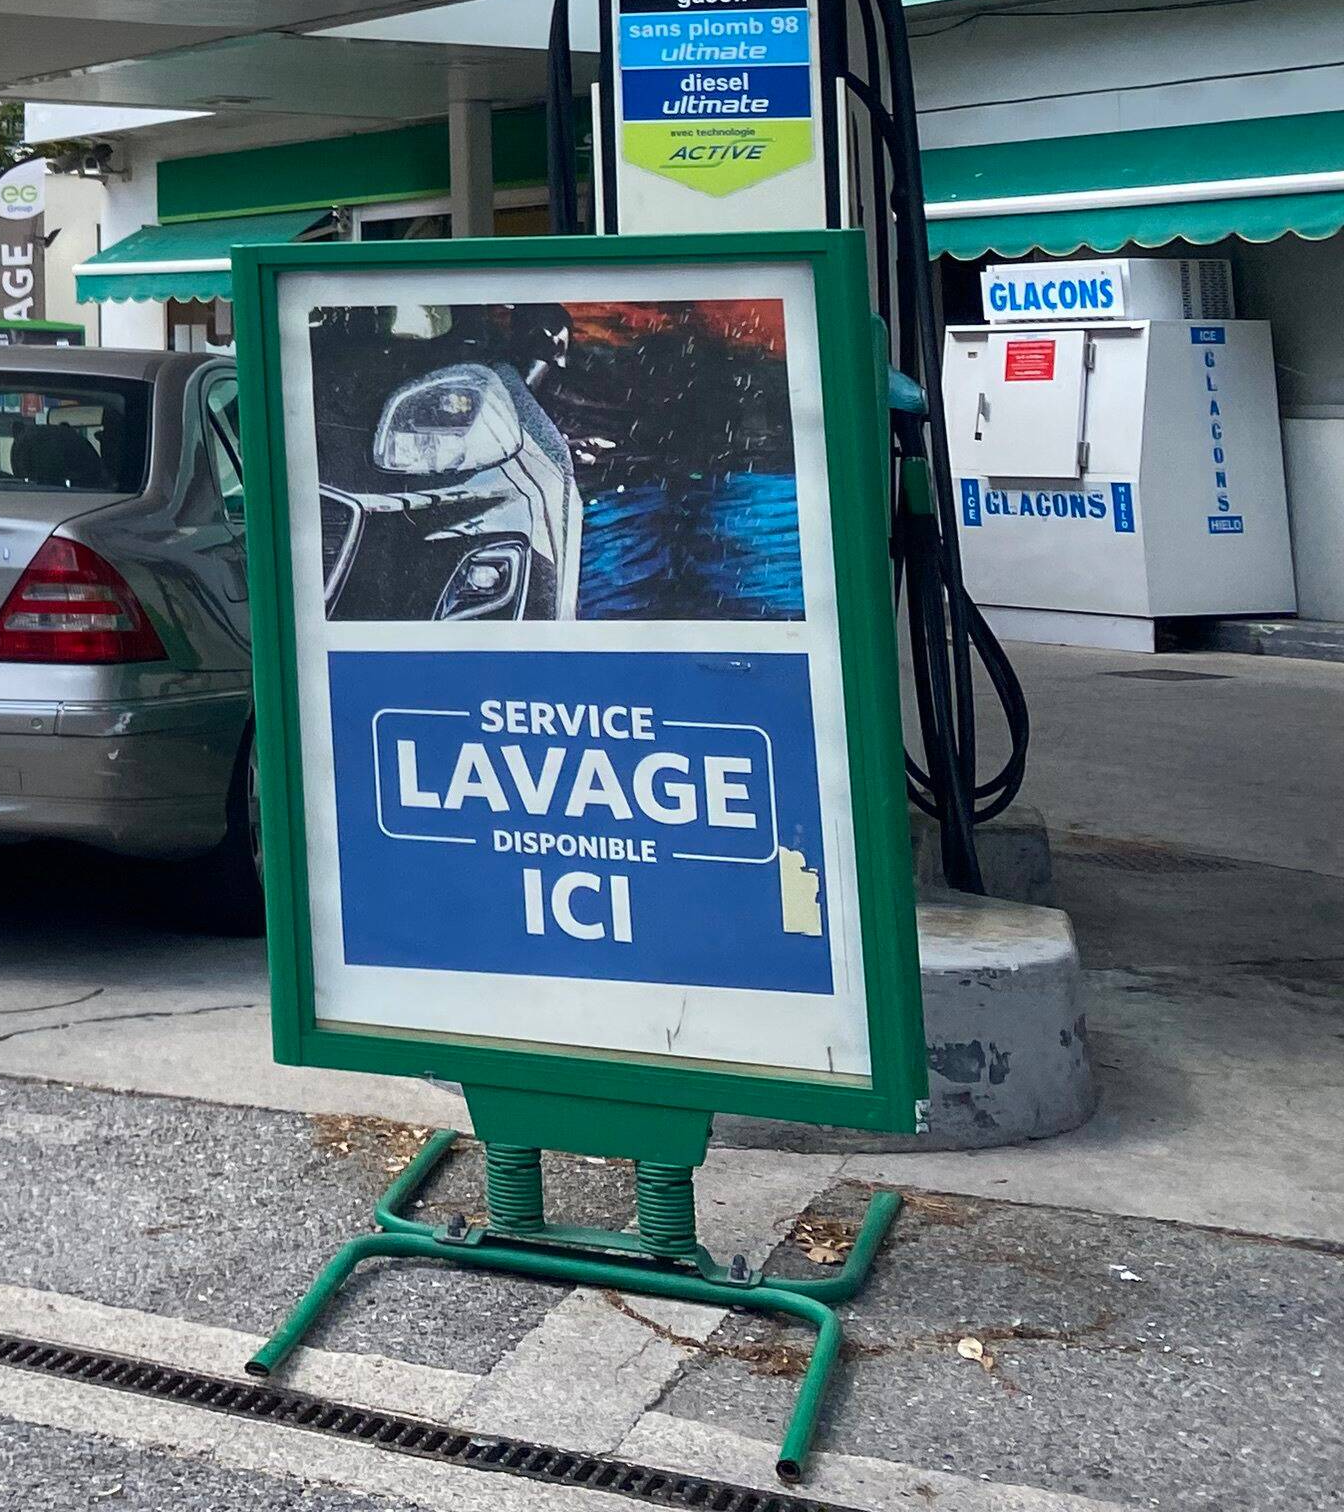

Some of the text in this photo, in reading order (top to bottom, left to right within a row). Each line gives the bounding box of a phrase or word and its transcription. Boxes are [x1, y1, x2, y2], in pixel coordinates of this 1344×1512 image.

[629, 16, 799, 40] sans plomb 98
[662, 41, 768, 62] ultimate
[680, 72, 750, 92] diesel
[663, 94, 769, 115] ultimate
[669, 144, 767, 162] ACTIVE
[1199, 330, 1217, 341] ICE
[967, 484, 977, 520] ICE
[1118, 486, 1129, 529] HIELO
[1210, 519, 1242, 531] HIELO
[481, 700, 655, 740] SERVICE
[396, 739, 758, 829] LAVAGE
[493, 829, 658, 864] DISPONIBLE
[523, 866, 633, 944] ICI
